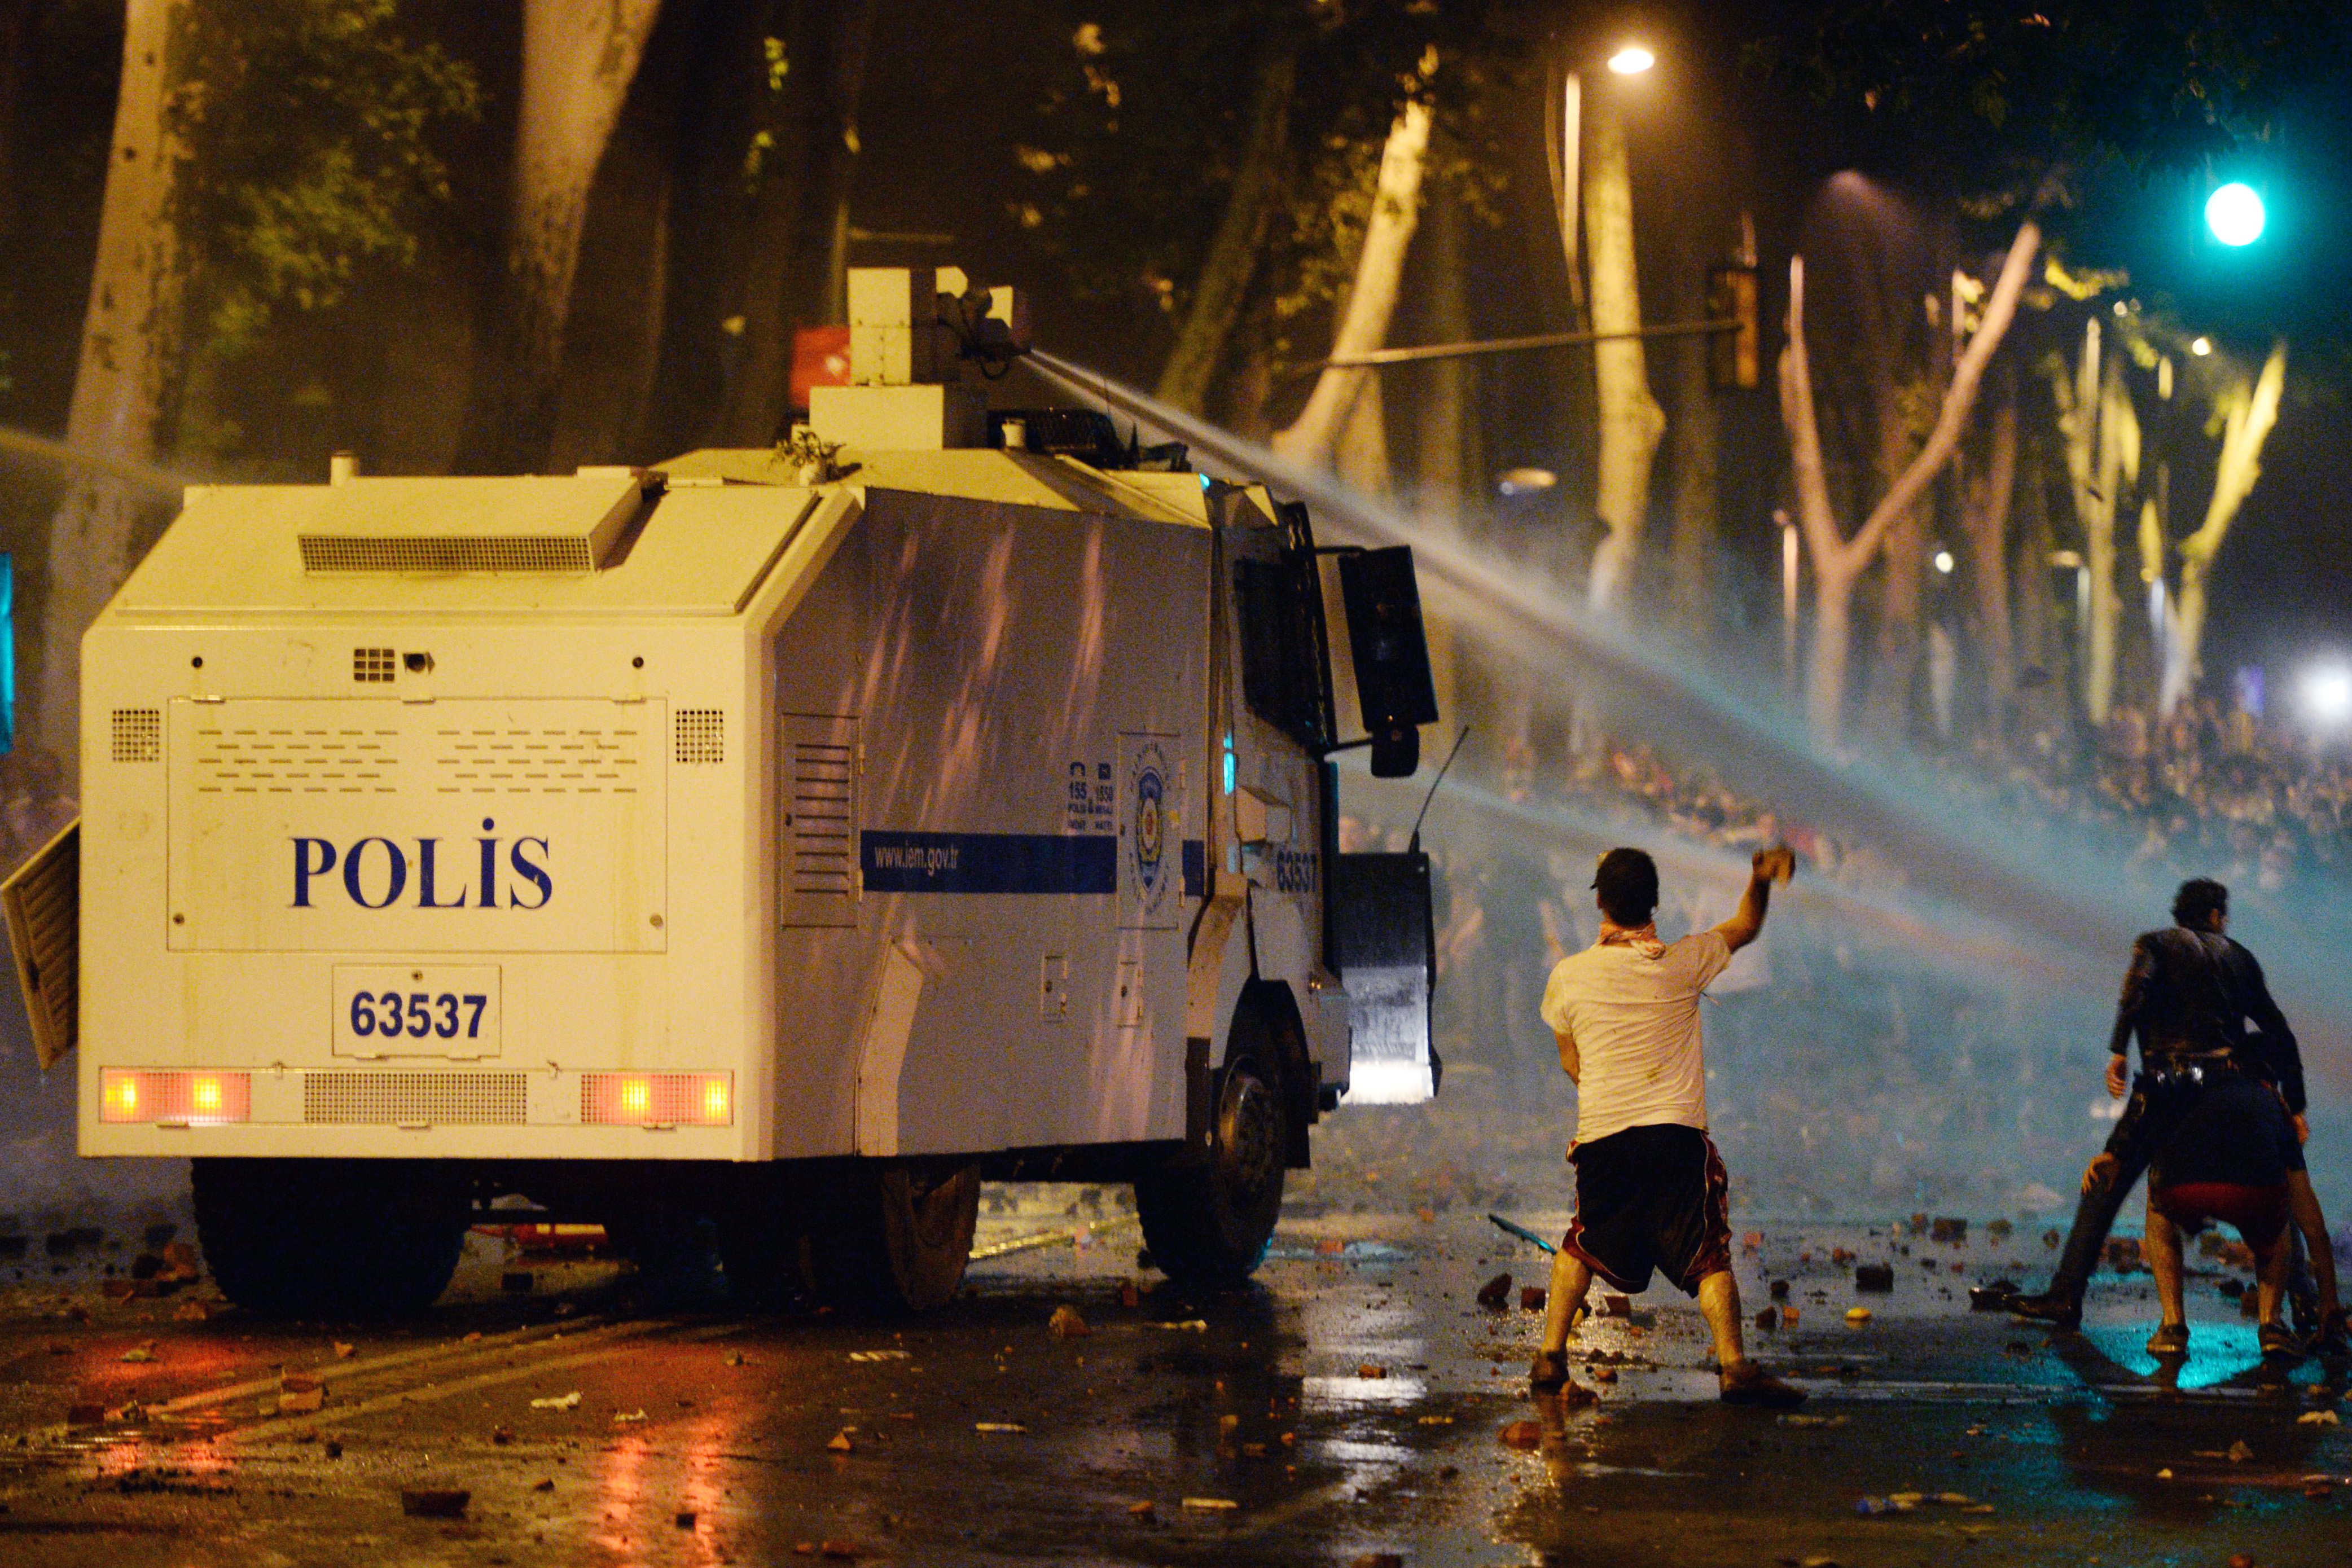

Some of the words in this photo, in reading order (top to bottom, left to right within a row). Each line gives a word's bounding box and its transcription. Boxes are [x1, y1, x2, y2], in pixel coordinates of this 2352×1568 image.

[288, 817, 552, 910] POLİS
[1277, 850, 1317, 893] 63537
[350, 991, 487, 1038] 63537
